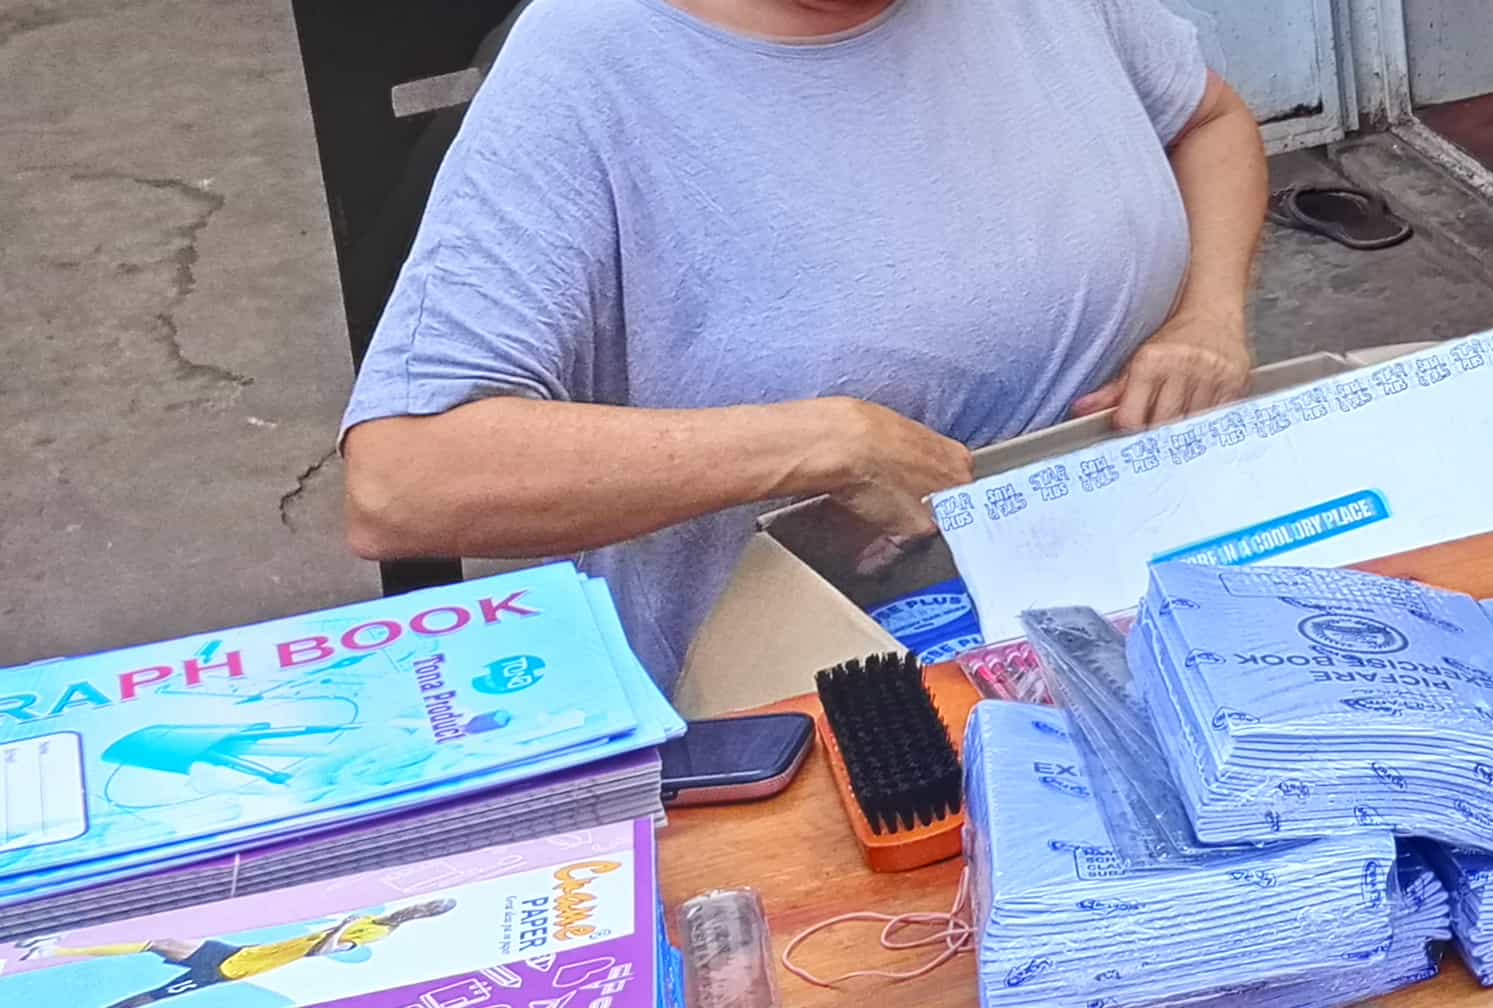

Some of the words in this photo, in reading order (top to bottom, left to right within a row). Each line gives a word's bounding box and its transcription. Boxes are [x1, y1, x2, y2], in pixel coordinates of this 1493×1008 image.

[1252, 525, 1293, 554] COOL
[1292, 515, 1324, 541] DRY
[1322, 498, 1373, 532] PLACE
[276, 590, 541, 668] BOOK
[414, 653, 446, 692] Tona
[1233, 653, 1336, 668] BOOK
[1309, 669, 1451, 691] PICFARE
[518, 895, 549, 952] PAPER
[552, 860, 622, 942] Crane
